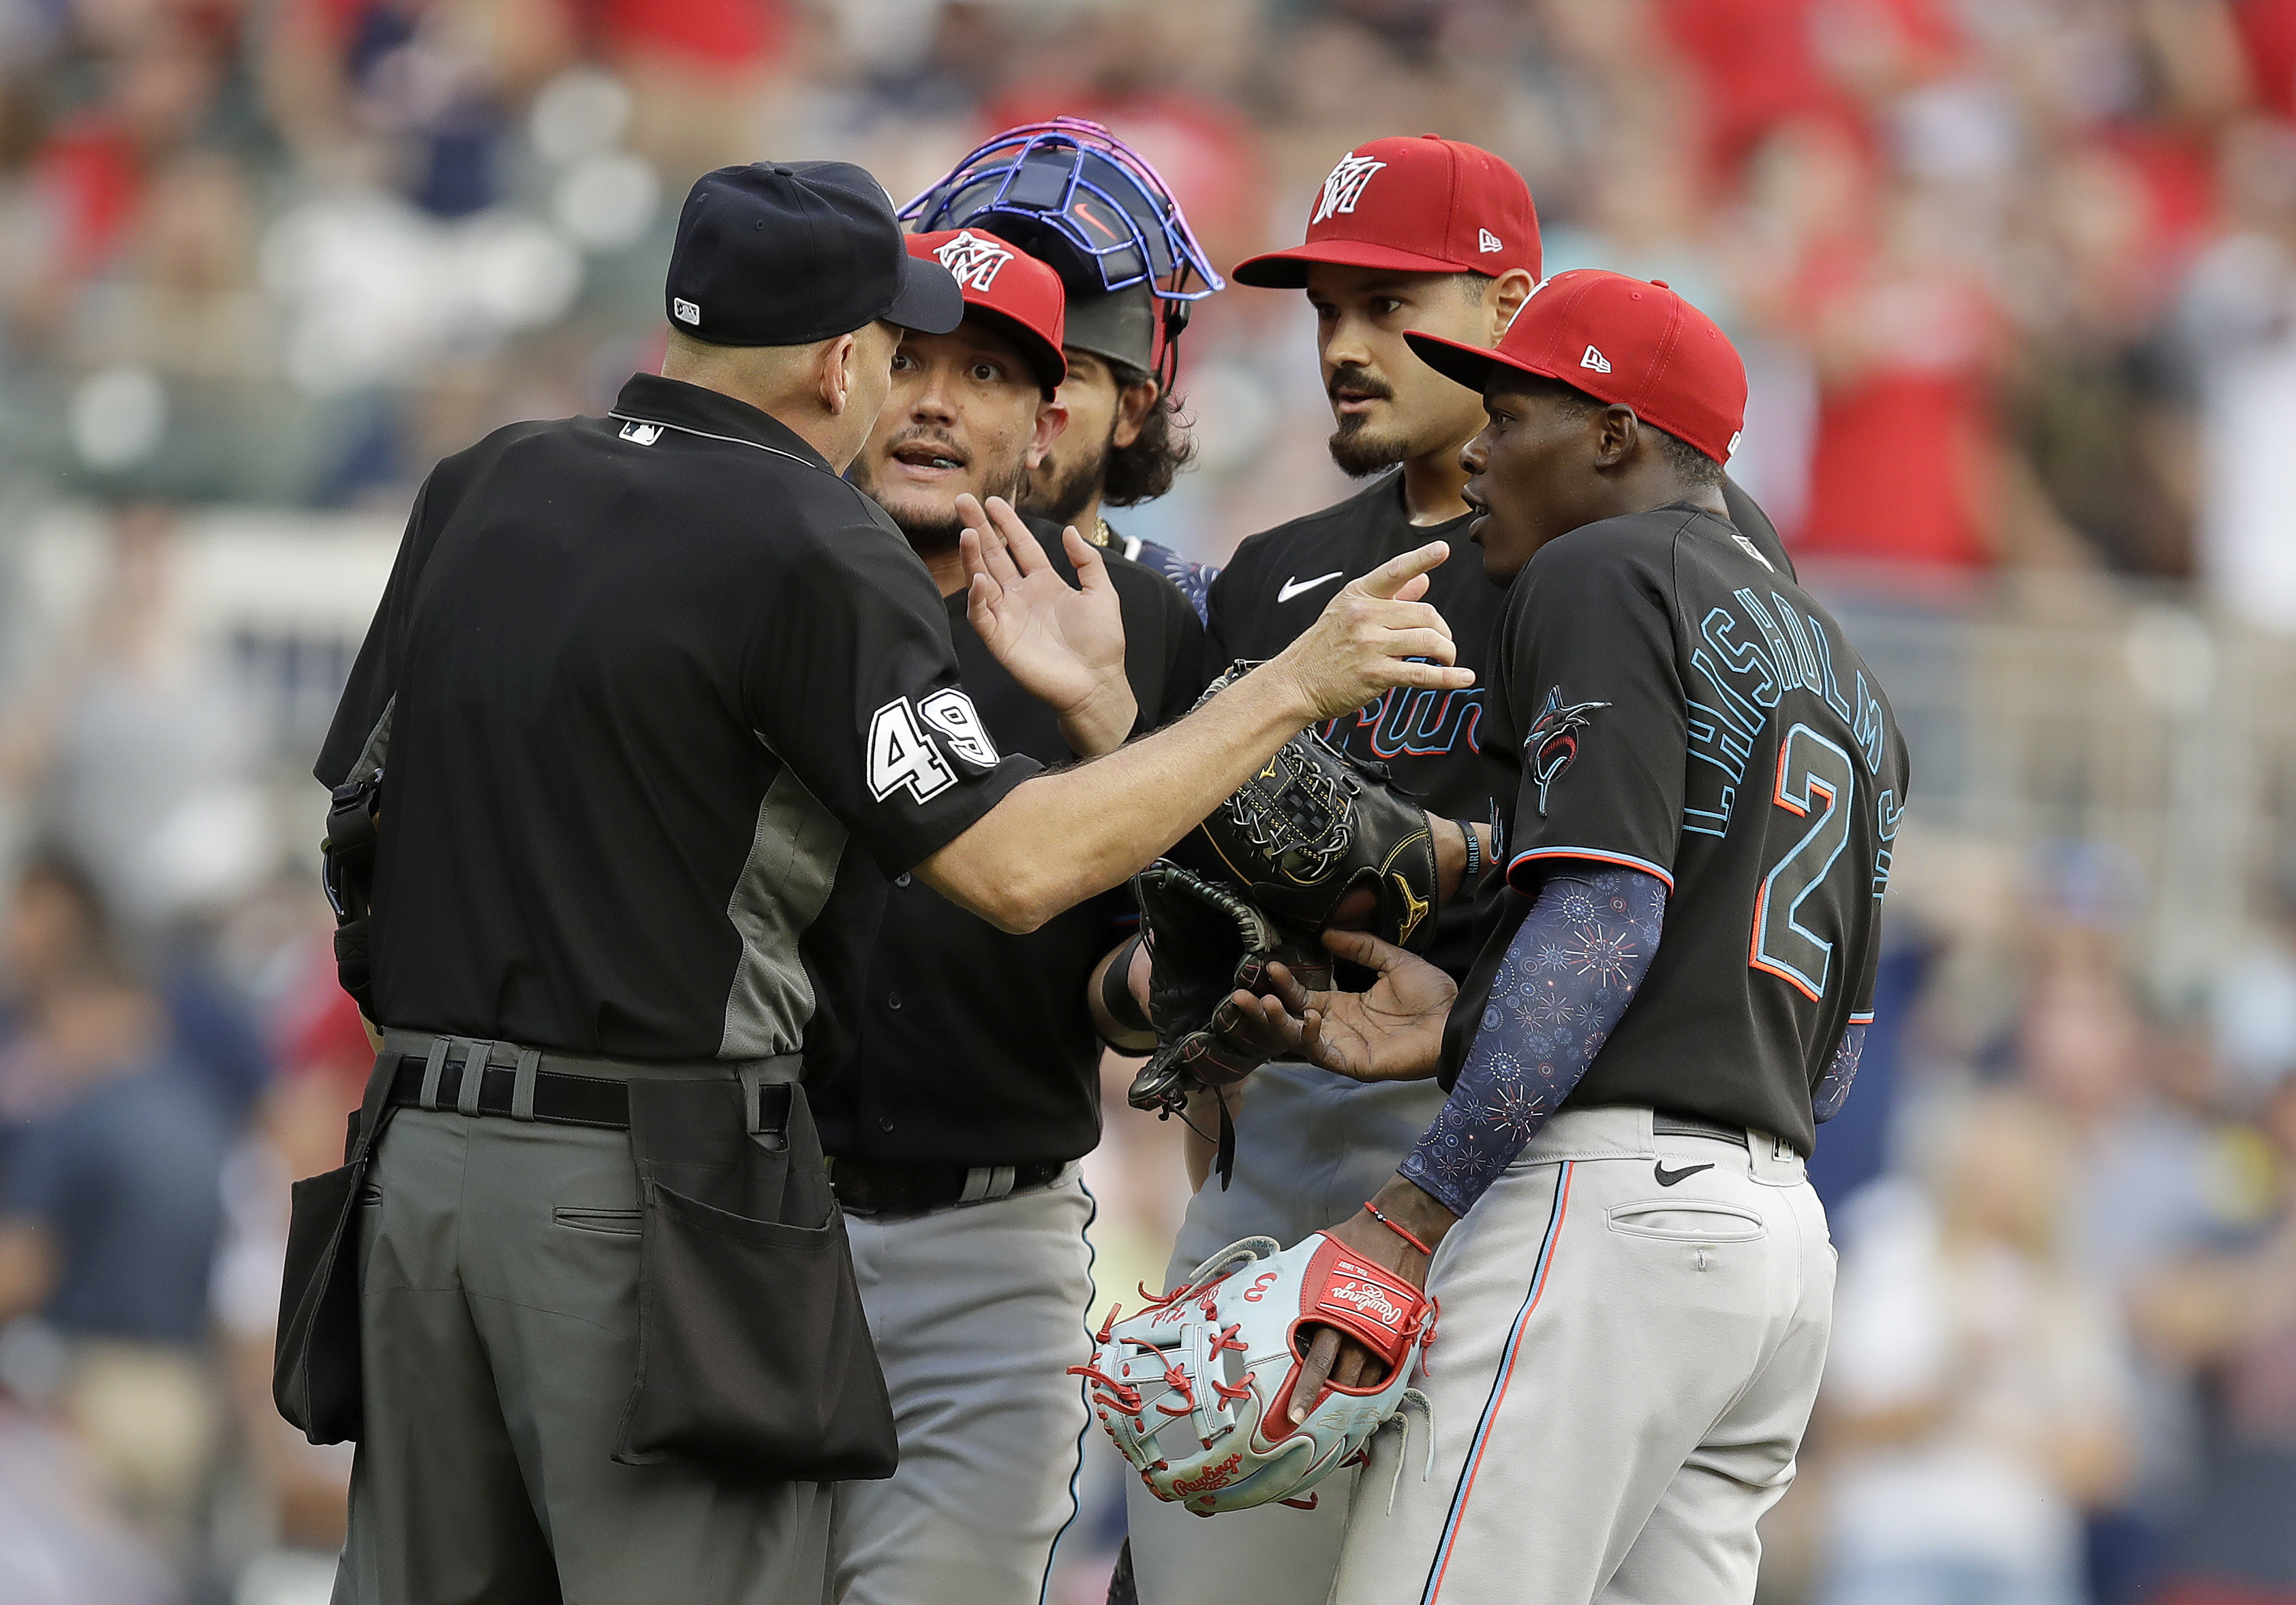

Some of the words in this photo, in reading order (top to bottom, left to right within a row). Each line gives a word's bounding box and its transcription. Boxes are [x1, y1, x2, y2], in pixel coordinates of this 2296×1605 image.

[866, 688, 1000, 805] 49
[1749, 722, 1854, 1003] 2
[1331, 1282, 1403, 1325] Rawlings
[1172, 1452, 1244, 1496] Rawlings
